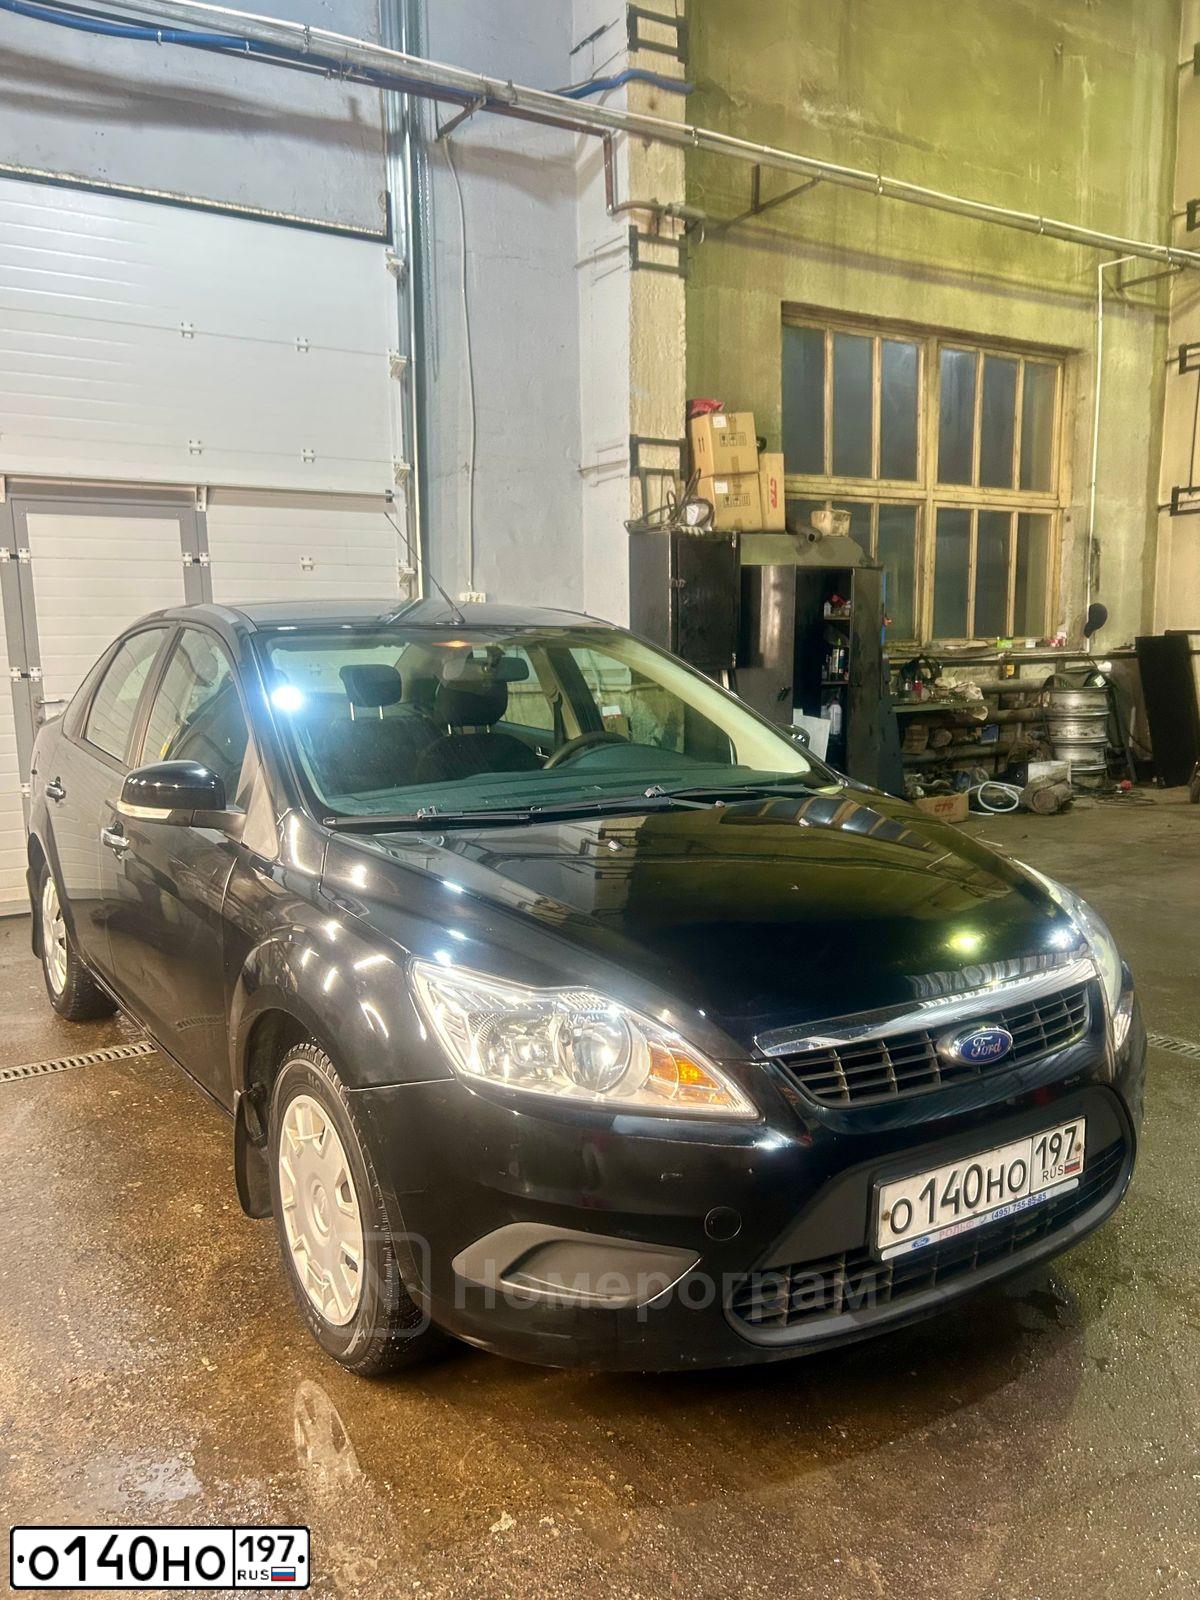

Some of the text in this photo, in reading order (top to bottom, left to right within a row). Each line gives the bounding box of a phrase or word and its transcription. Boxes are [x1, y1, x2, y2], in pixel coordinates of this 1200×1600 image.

[970, 1035, 1002, 1057] Ford
[1035, 1125, 1078, 1170] 197
[1042, 1166, 1064, 1182] RUS
